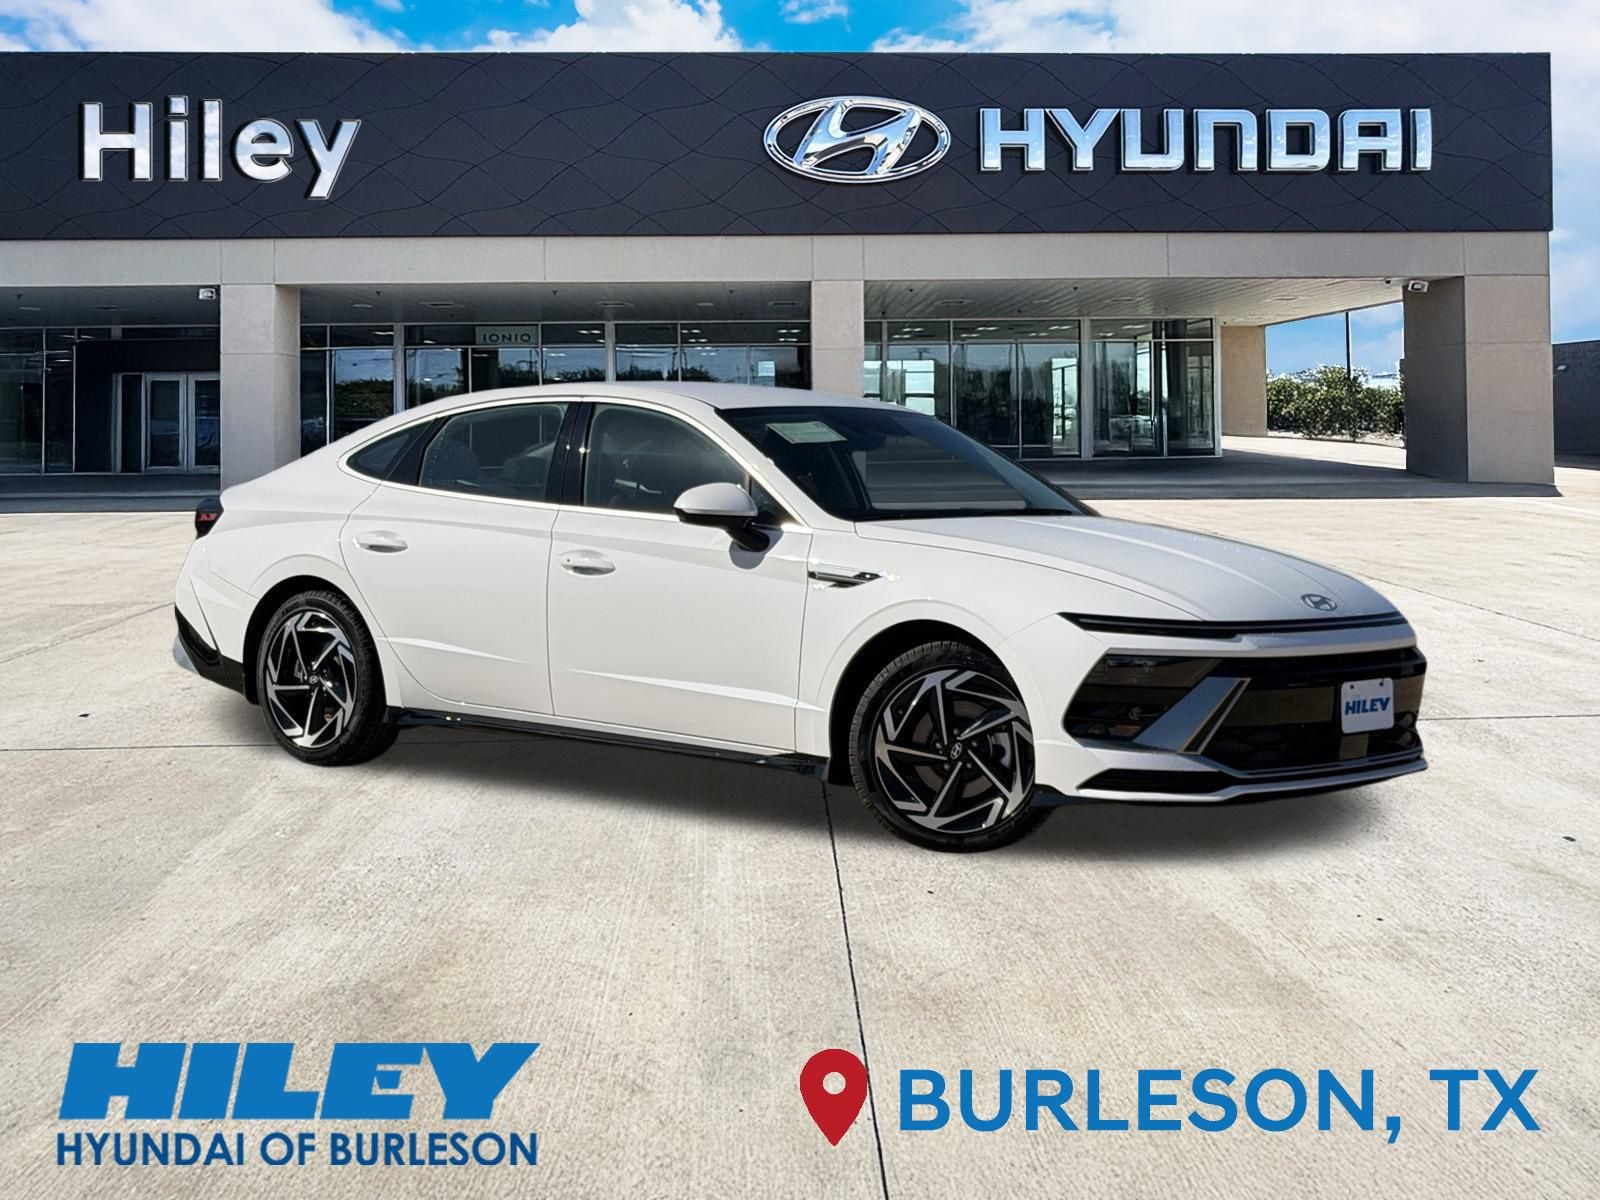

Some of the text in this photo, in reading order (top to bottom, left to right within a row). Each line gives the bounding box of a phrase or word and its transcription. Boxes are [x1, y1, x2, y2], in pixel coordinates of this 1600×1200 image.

[80, 95, 362, 200] Hiley
[978, 107, 1434, 172] HYUNDAI
[1344, 696, 1391, 716] HILEY
